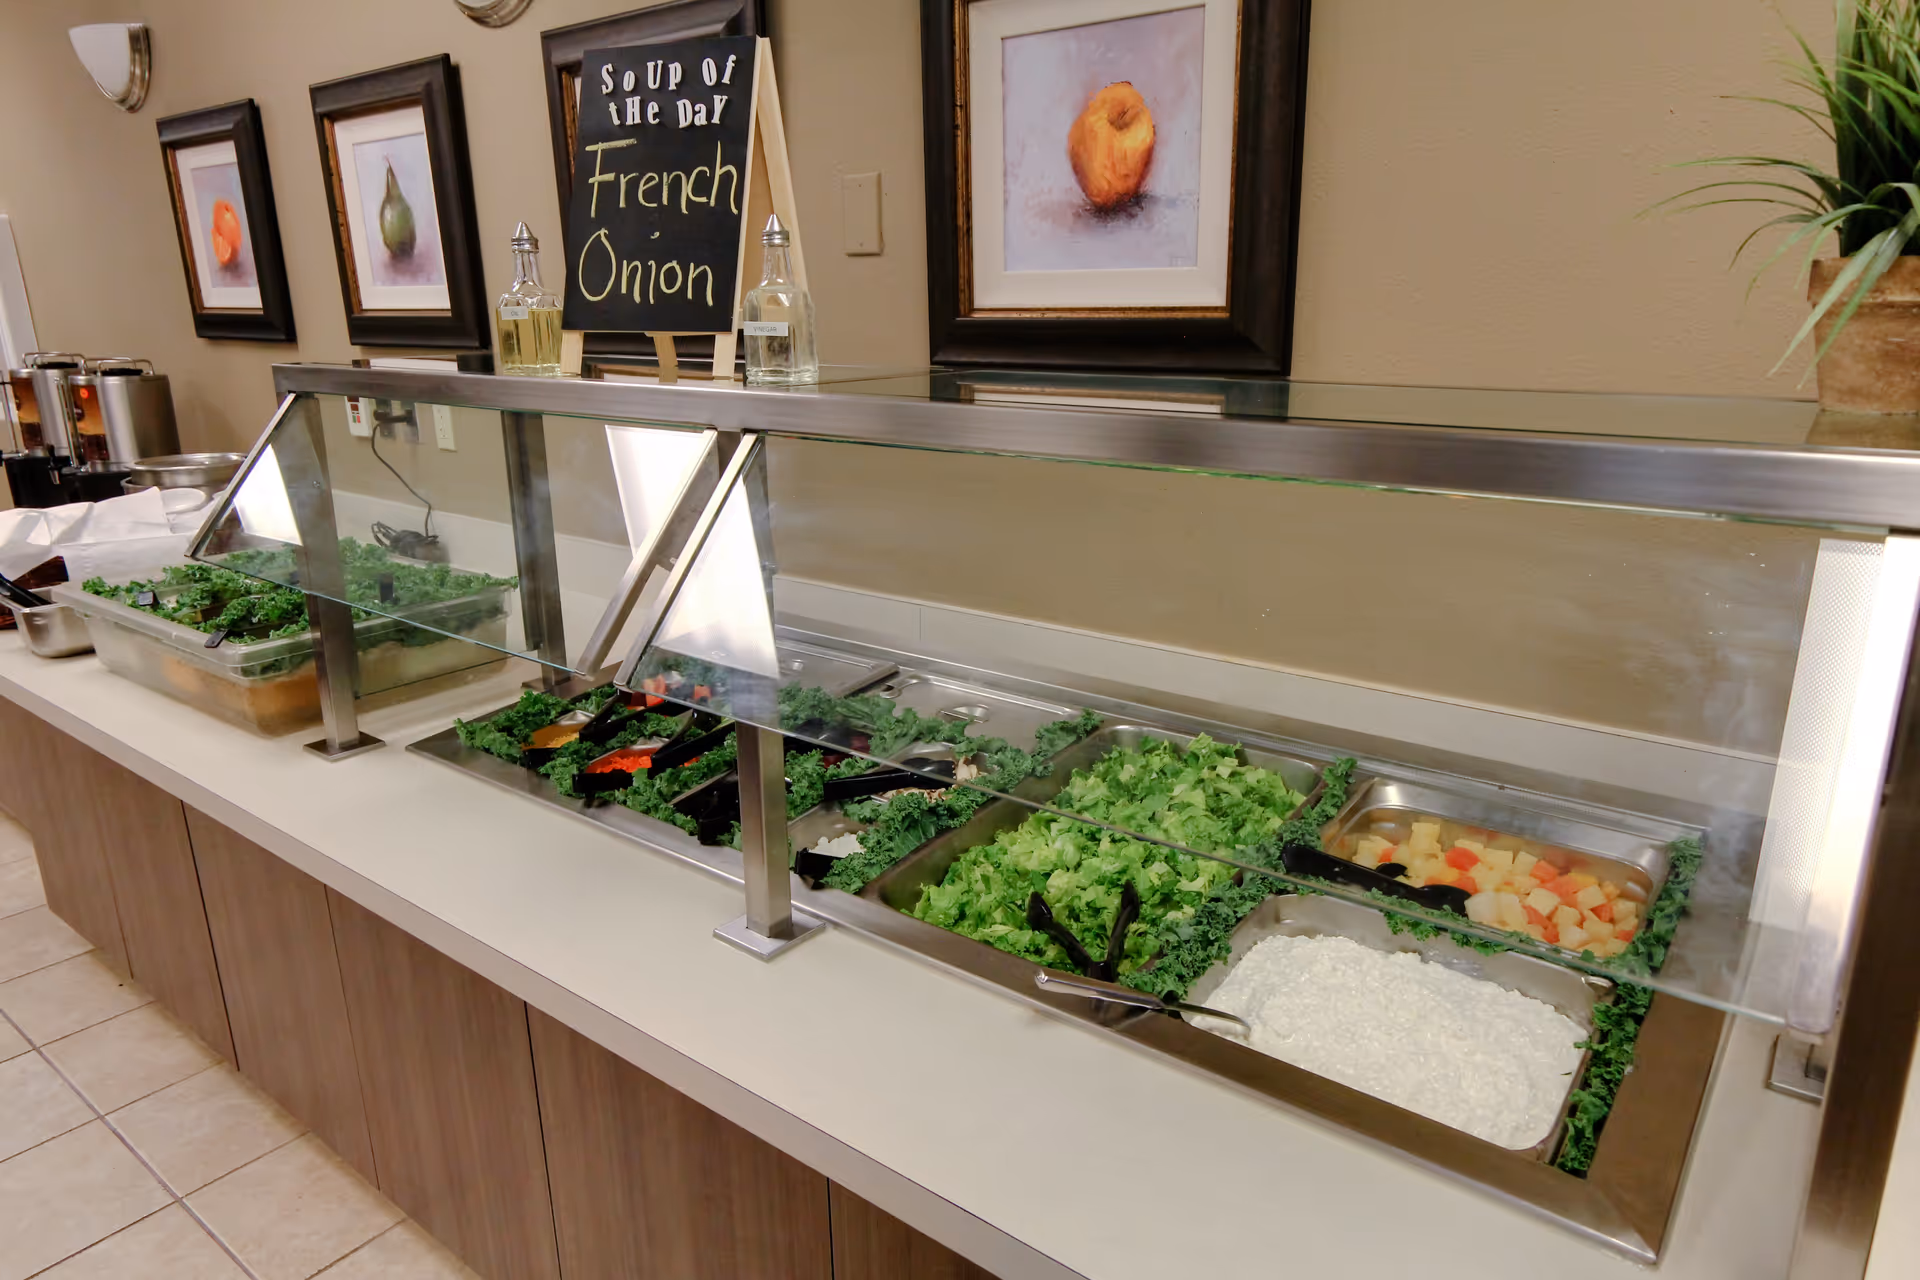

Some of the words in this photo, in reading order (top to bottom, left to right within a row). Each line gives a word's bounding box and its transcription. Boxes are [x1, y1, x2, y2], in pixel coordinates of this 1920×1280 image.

[609, 96, 660, 126] tHe
[585, 138, 739, 218] French
[578, 228, 714, 307] Onion
